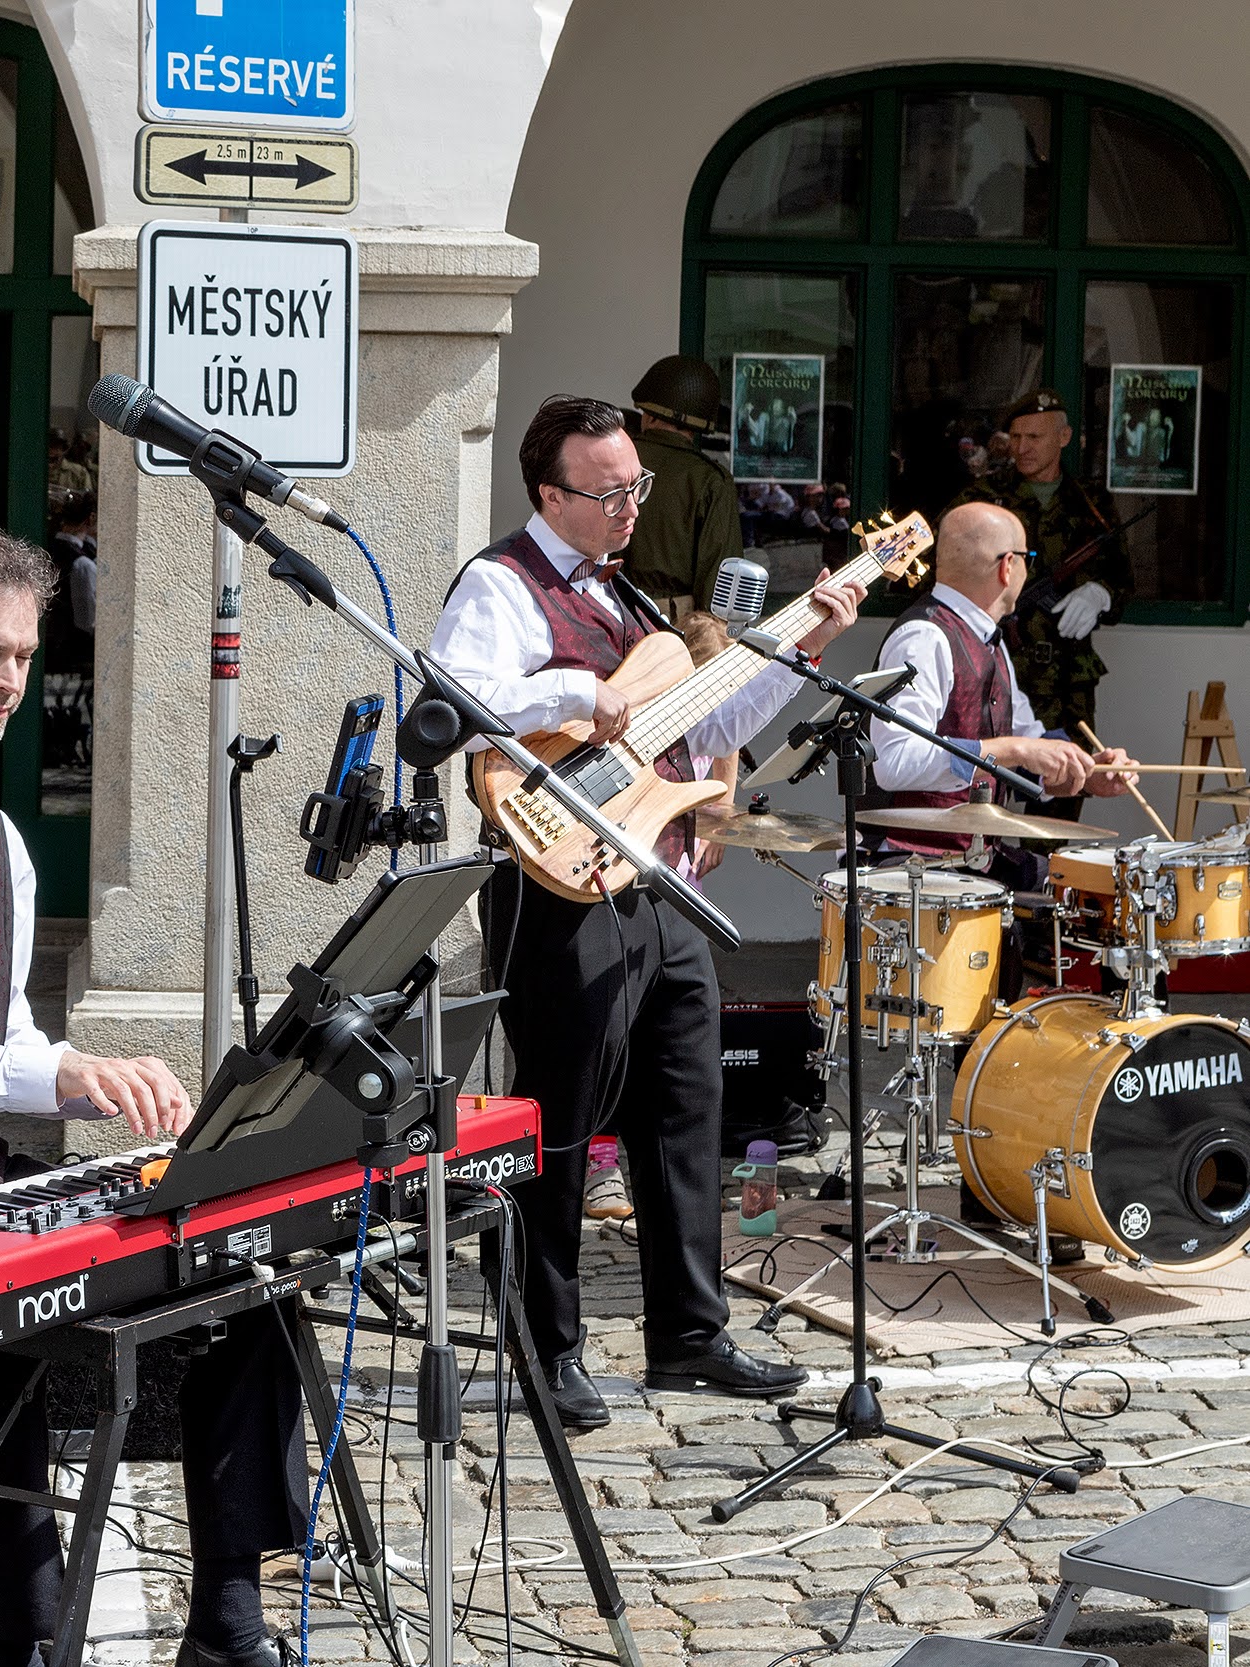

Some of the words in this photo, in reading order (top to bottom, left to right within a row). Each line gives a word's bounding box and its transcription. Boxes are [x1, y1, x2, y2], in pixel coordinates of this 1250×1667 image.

[167, 45, 337, 100] RÉSERVÉ
[237, 148, 247, 158] m
[257, 146, 269, 160] 23
[274, 150, 283, 160] m
[168, 274, 333, 339] MĚSTSKÝ
[203, 354, 298, 417] ÚŘAD
[1144, 1052, 1243, 1097] YAMAHA
[459, 1152, 515, 1186] stage
[516, 1153, 535, 1174] EX
[18, 1274, 86, 1329] nord
